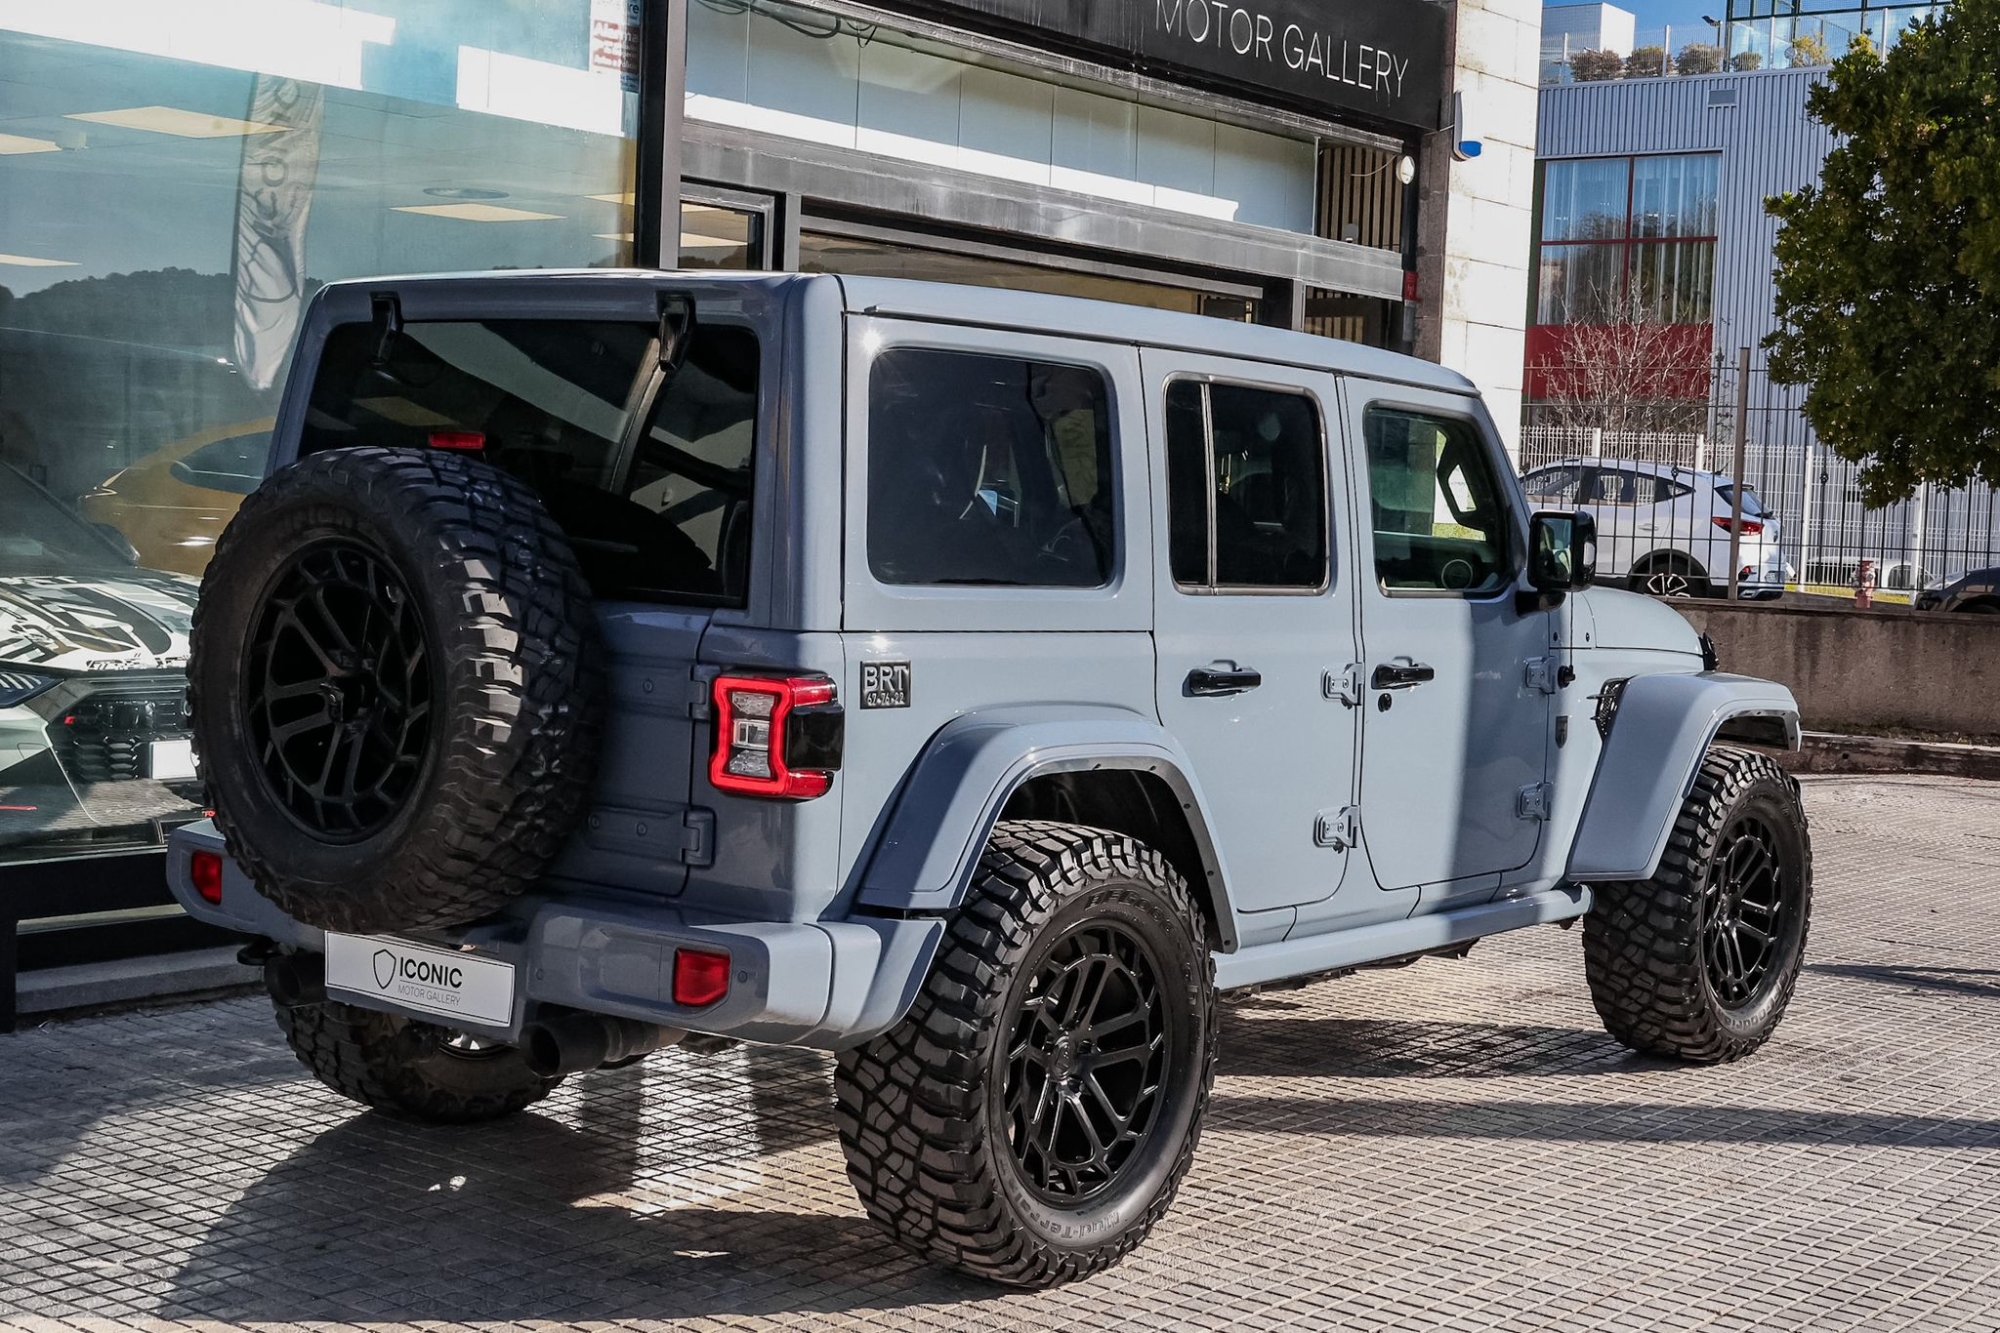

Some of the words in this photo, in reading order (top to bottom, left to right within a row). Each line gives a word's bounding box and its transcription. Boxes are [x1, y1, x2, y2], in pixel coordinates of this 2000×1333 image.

[1156, 0, 1273, 62] MOTOR
[1282, 24, 1409, 98] GALLERY
[864, 665, 907, 691] BRT
[399, 956, 463, 988] ICONIC
[397, 984, 425, 998] MOTOR
[426, 990, 461, 1006] GALLERY
